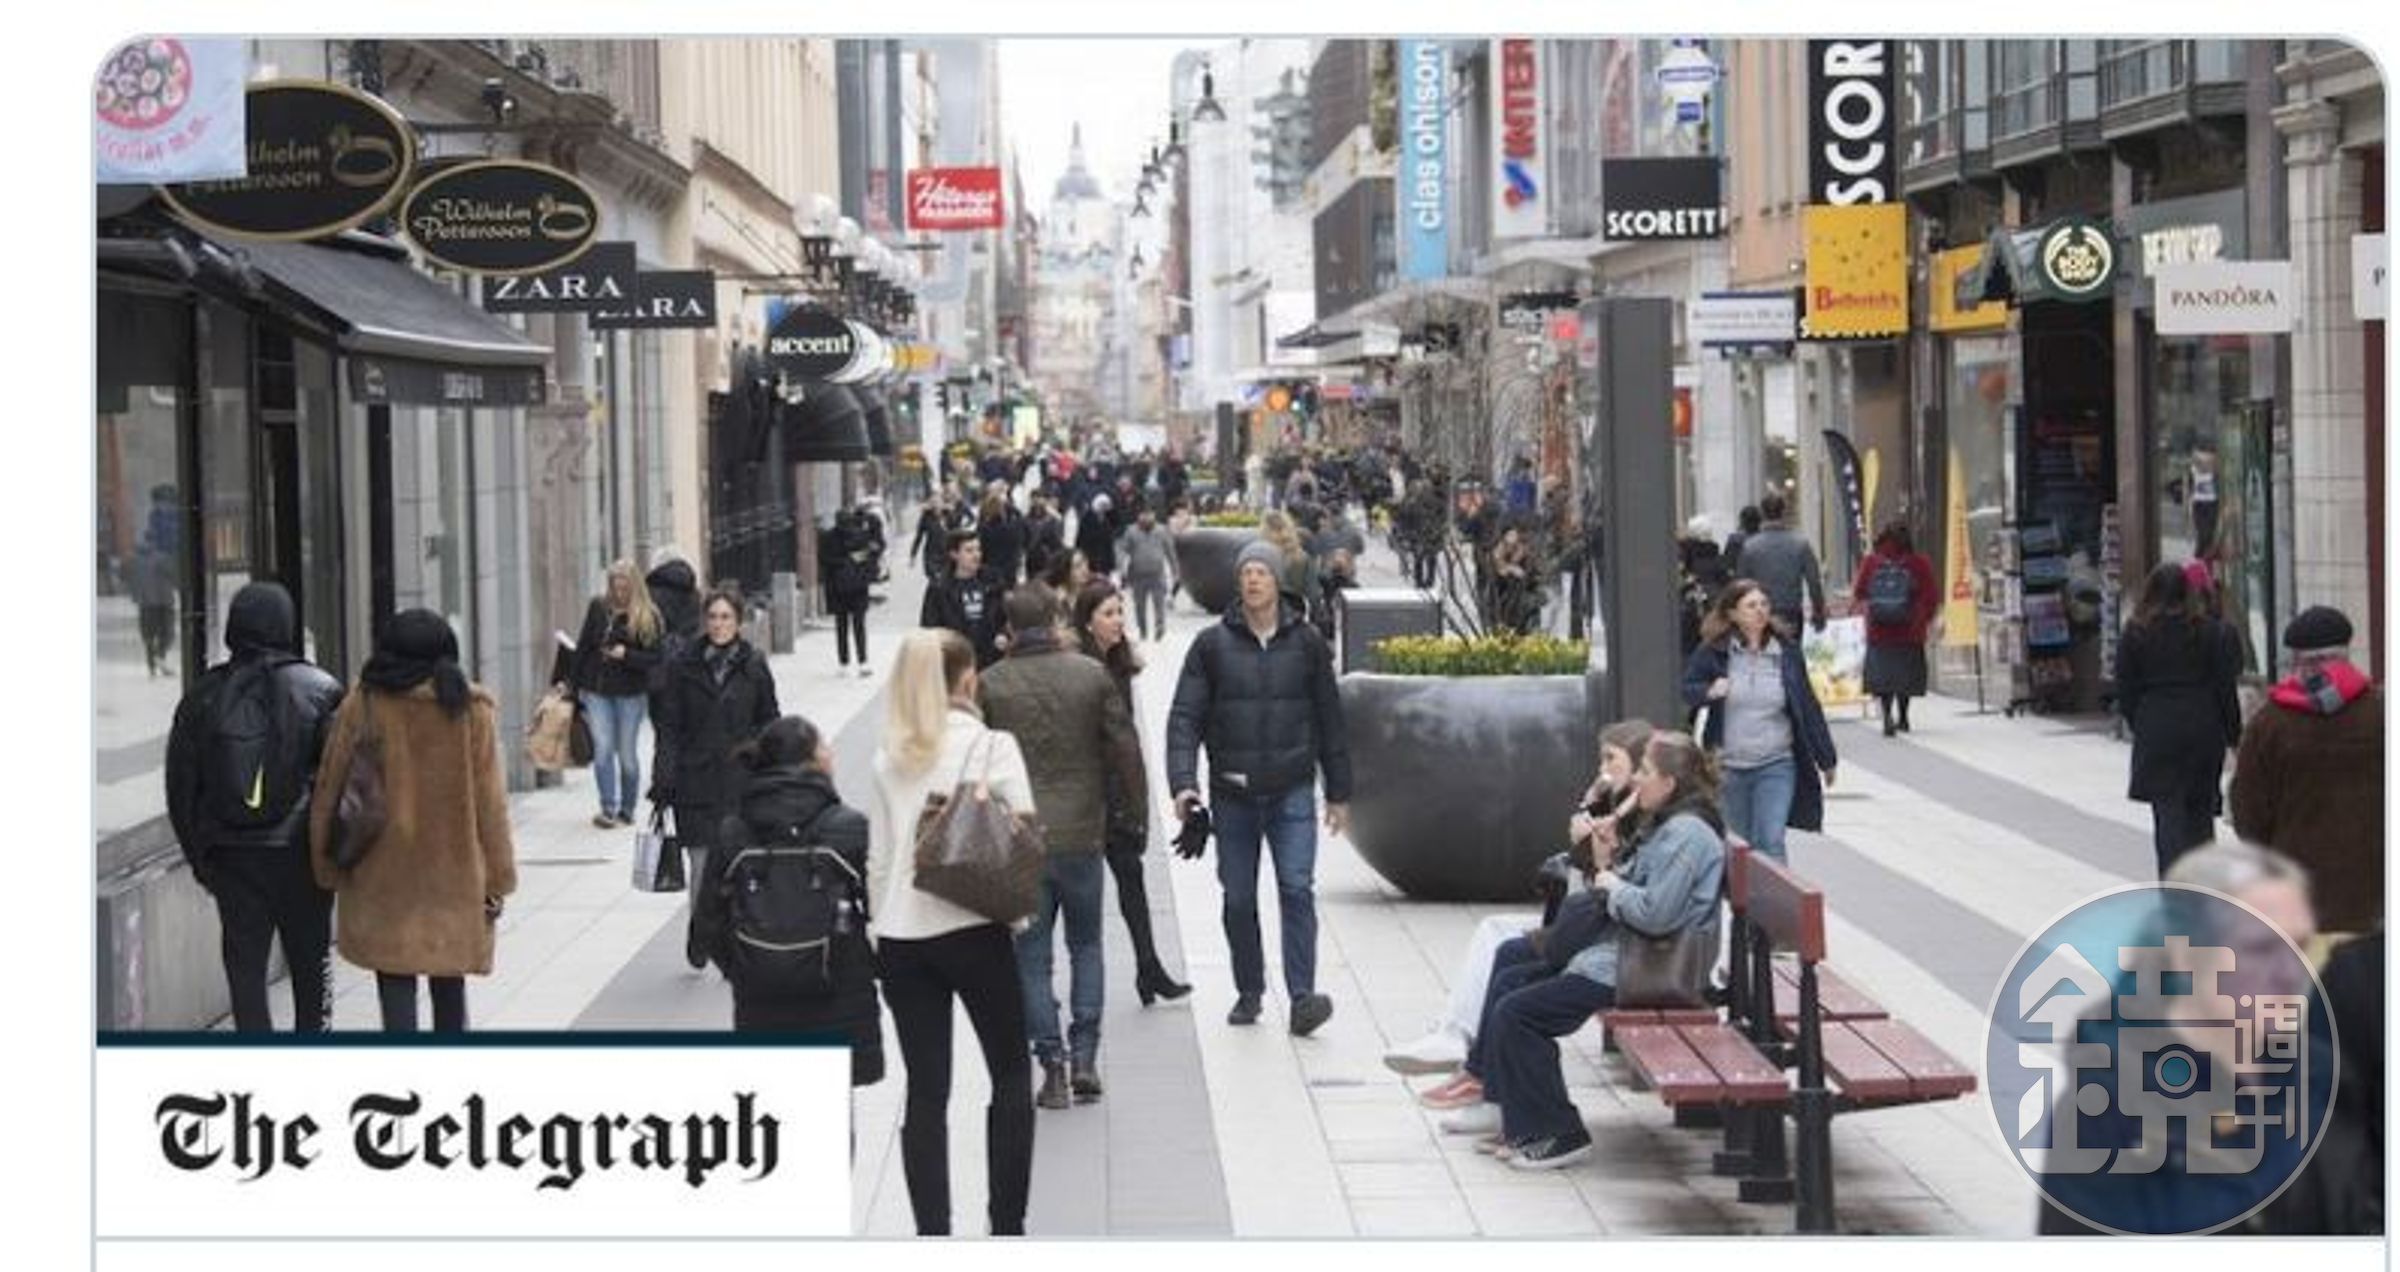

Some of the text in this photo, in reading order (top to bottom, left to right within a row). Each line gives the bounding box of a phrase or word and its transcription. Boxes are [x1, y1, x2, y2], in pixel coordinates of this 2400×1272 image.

[1408, 44, 1440, 229] clas ohlson
[431, 198, 532, 220] Wilhelm
[413, 216, 531, 240] Pettersson
[1606, 208, 1716, 236] SCORETT
[2057, 254, 2099, 269] BODY
[494, 276, 623, 300] ZARA
[771, 334, 850, 353] accent
